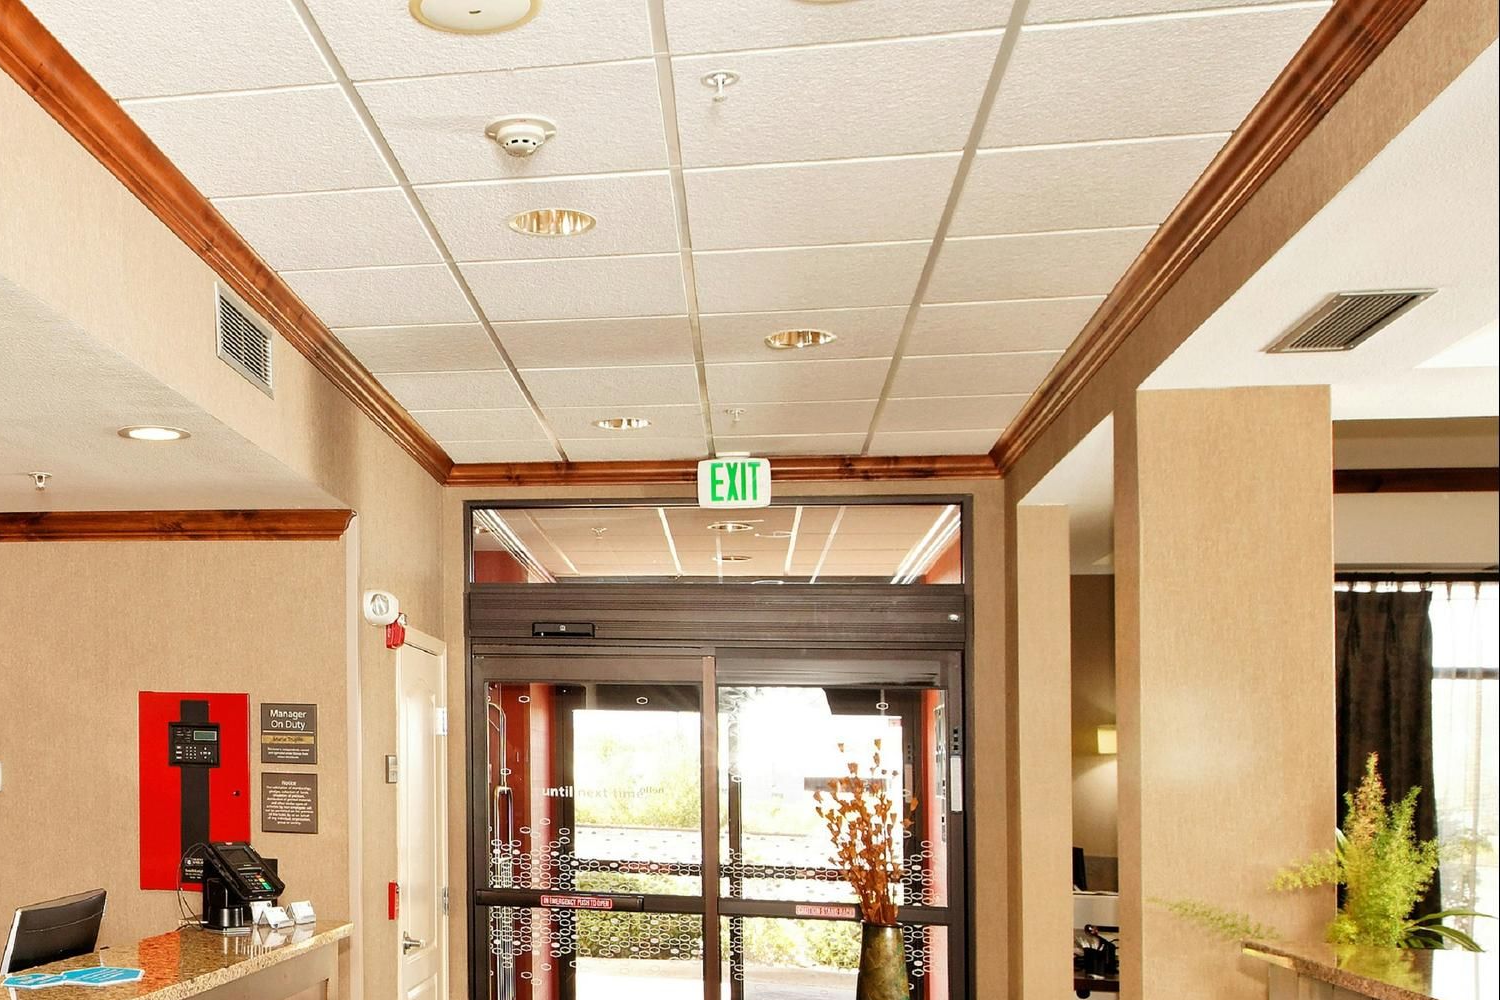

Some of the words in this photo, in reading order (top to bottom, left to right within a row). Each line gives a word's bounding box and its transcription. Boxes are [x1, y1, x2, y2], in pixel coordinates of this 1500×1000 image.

[711, 462, 760, 501] EXIT
[270, 709, 307, 720] Manager
[270, 719, 284, 728] On
[285, 720, 306, 731] Duty
[542, 786, 574, 798] until
[578, 788, 608, 798] next
